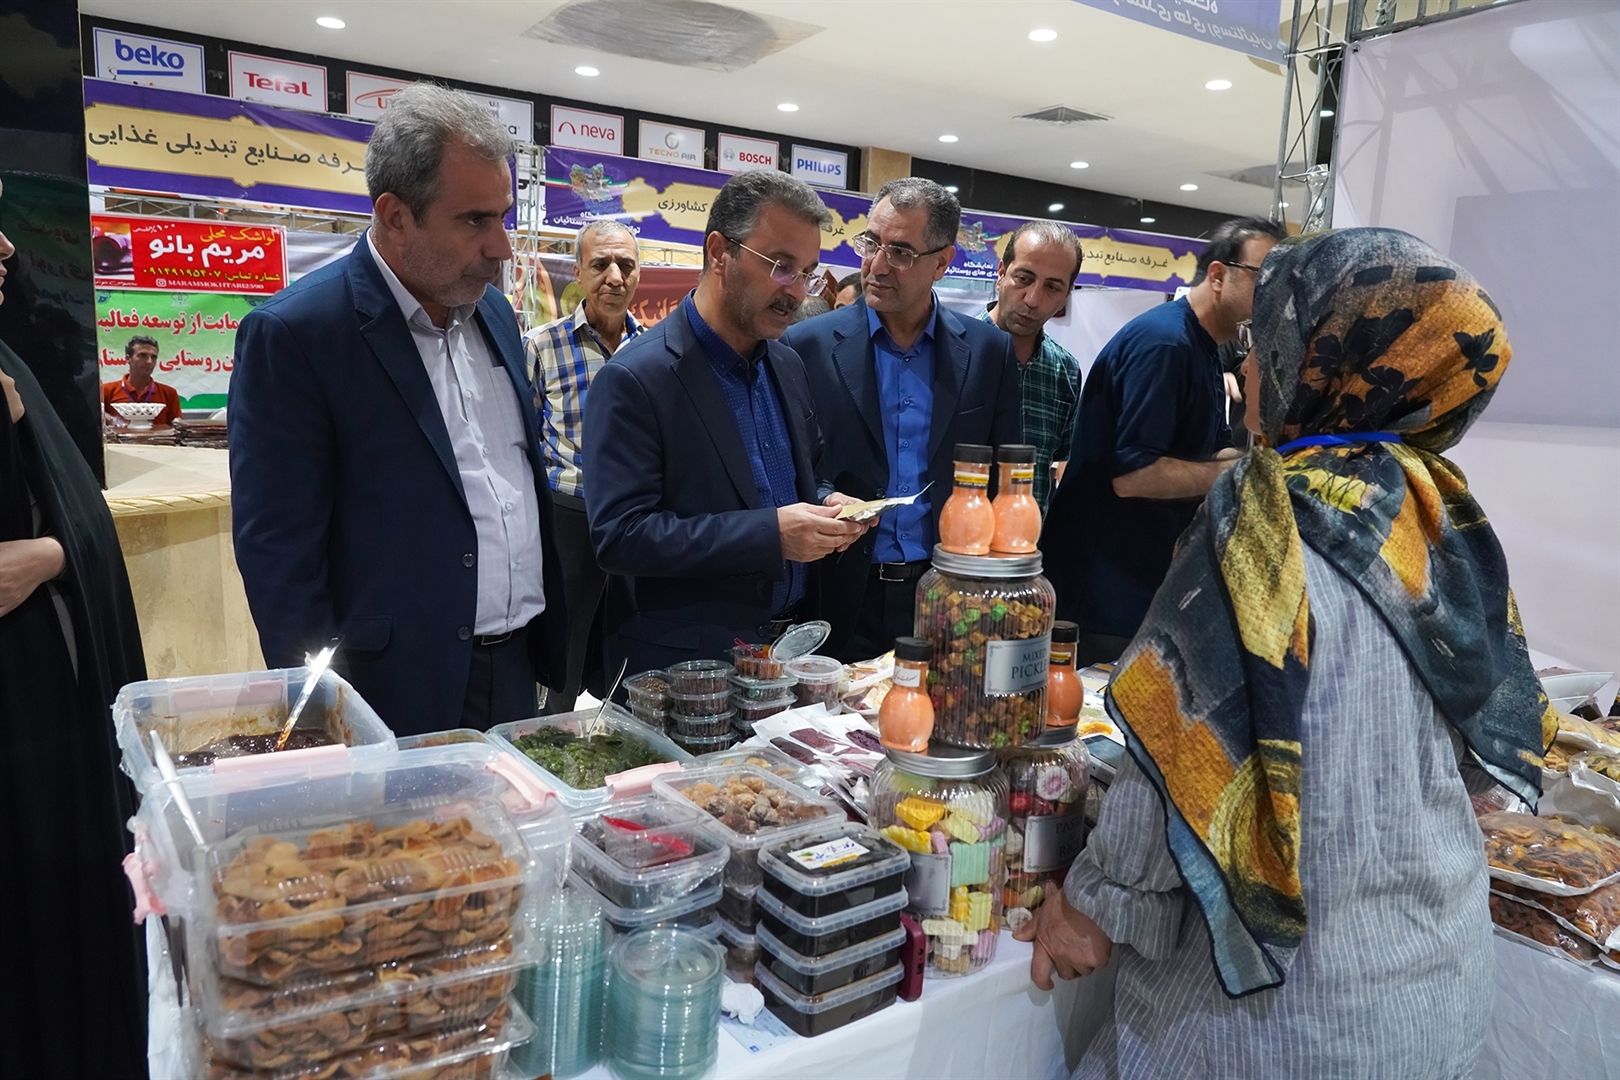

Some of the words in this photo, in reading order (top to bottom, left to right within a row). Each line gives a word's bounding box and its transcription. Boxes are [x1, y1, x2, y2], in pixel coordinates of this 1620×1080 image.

[114, 38, 185, 70] beko
[243, 71, 313, 97] Tefal
[88, 124, 158, 145] غذایی
[580, 123, 615, 141] neva
[165, 133, 238, 158] تبدیلی
[244, 143, 312, 166] صنایع
[648, 147, 680, 158] TECNO
[680, 152, 697, 161] AIR
[317, 152, 366, 174] رفه
[739, 151, 772, 165] BOSCH
[797, 158, 842, 176] PHILIPS
[657, 199, 708, 213] کشاورزی
[149, 234, 195, 262] بانو
[201, 242, 265, 268] مریم
[142, 312, 186, 335] توسعه
[188, 312, 201, 335] از
[204, 313, 239, 335] مایت
[159, 349, 221, 372] روستایی
[1022, 647, 1047, 663] MIXED
